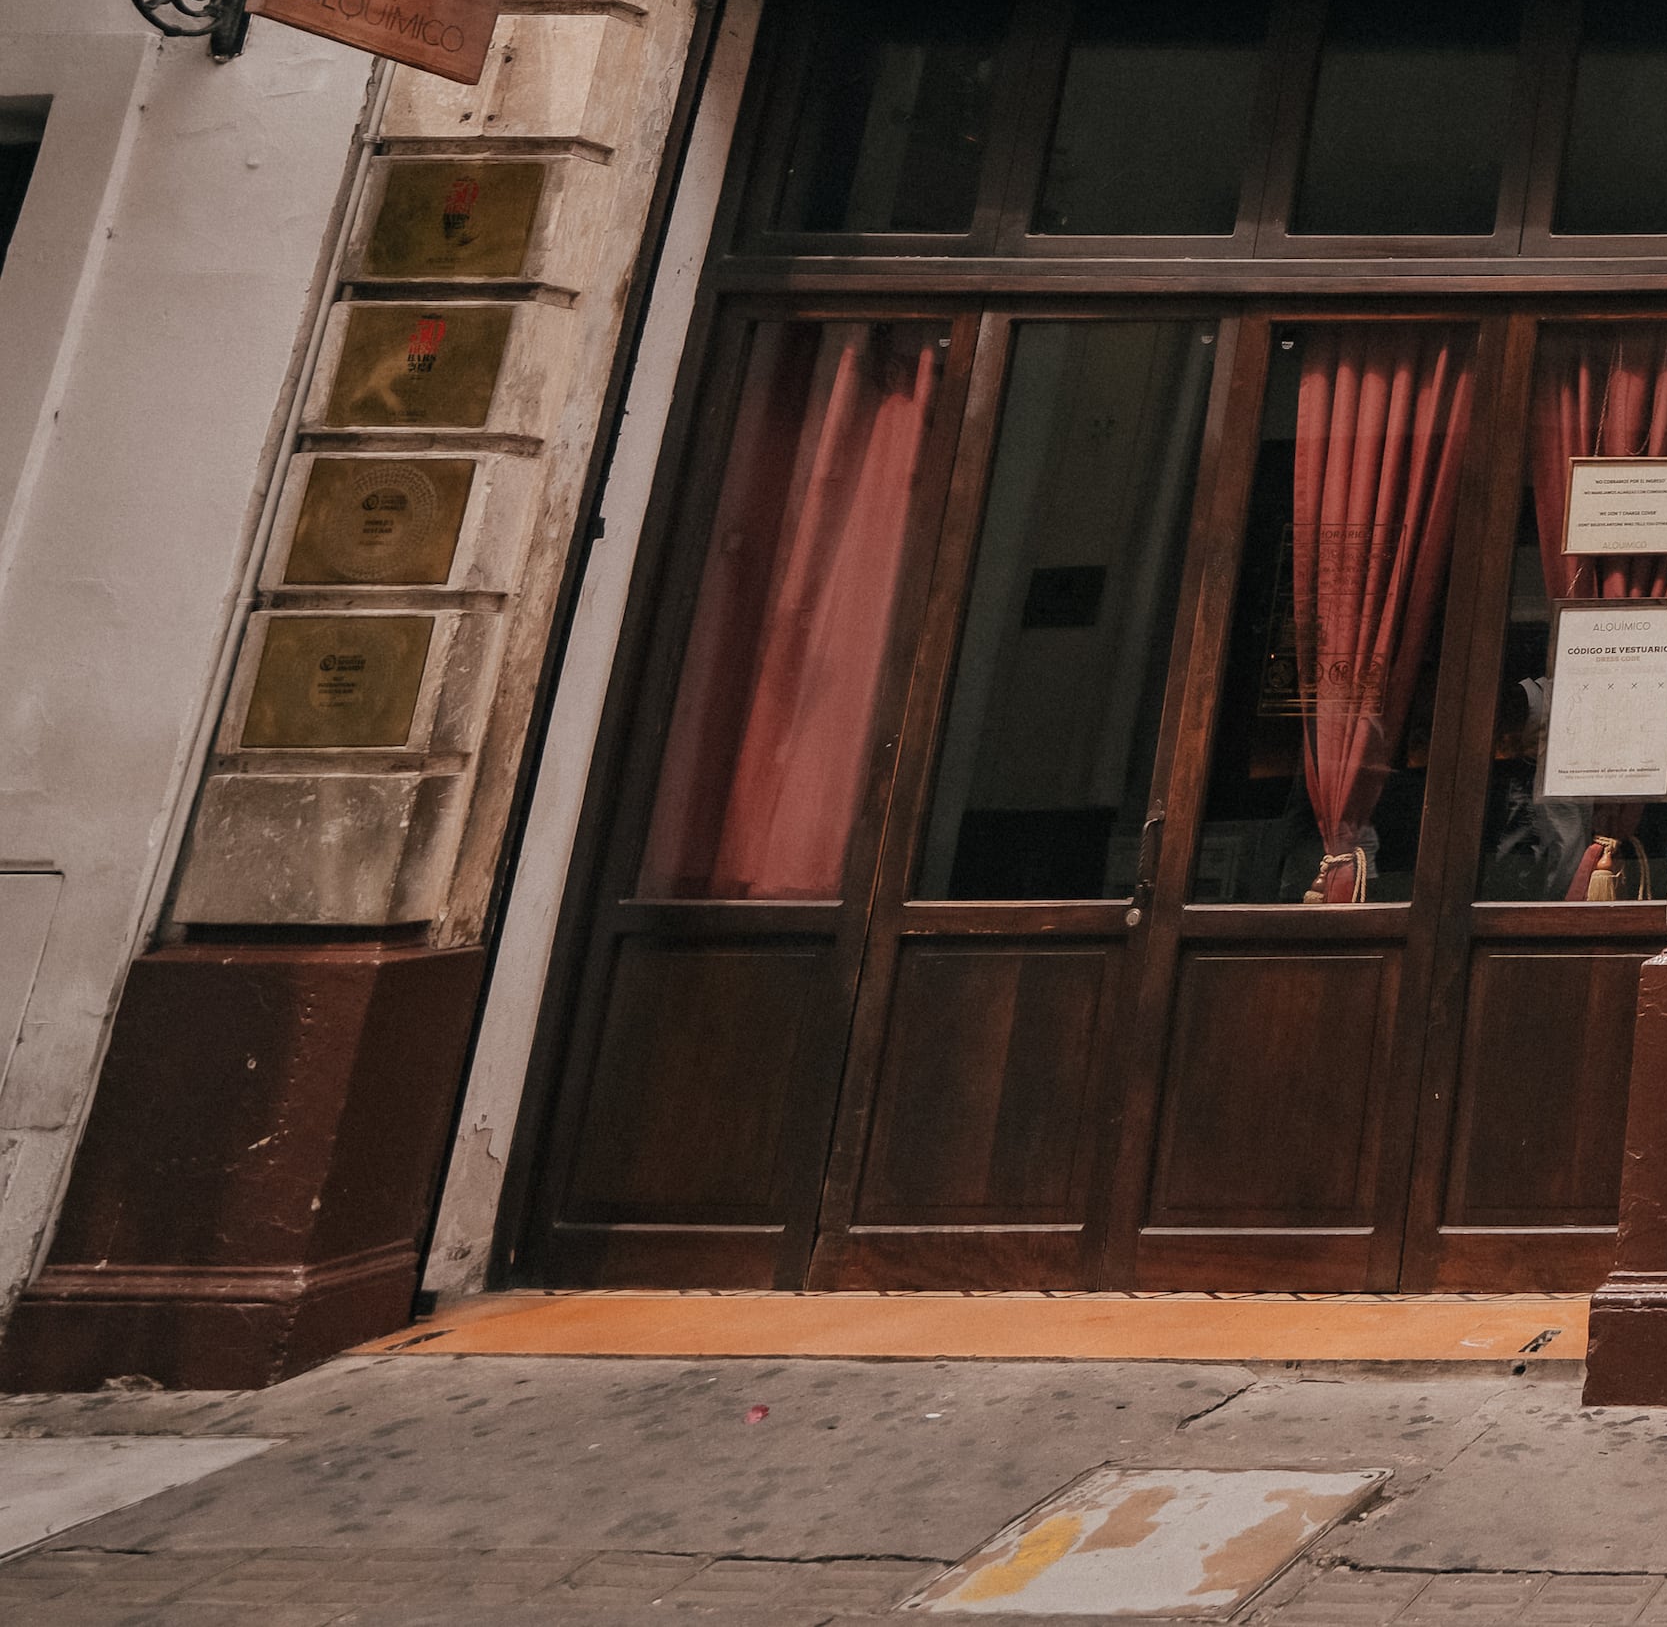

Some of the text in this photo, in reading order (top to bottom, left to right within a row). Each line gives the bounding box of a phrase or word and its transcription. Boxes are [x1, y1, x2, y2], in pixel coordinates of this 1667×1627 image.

[409, 319, 447, 343] 50
[1592, 620, 1652, 632] ALQUÍMICO
[1567, 646, 1603, 655] CÓDIGO
